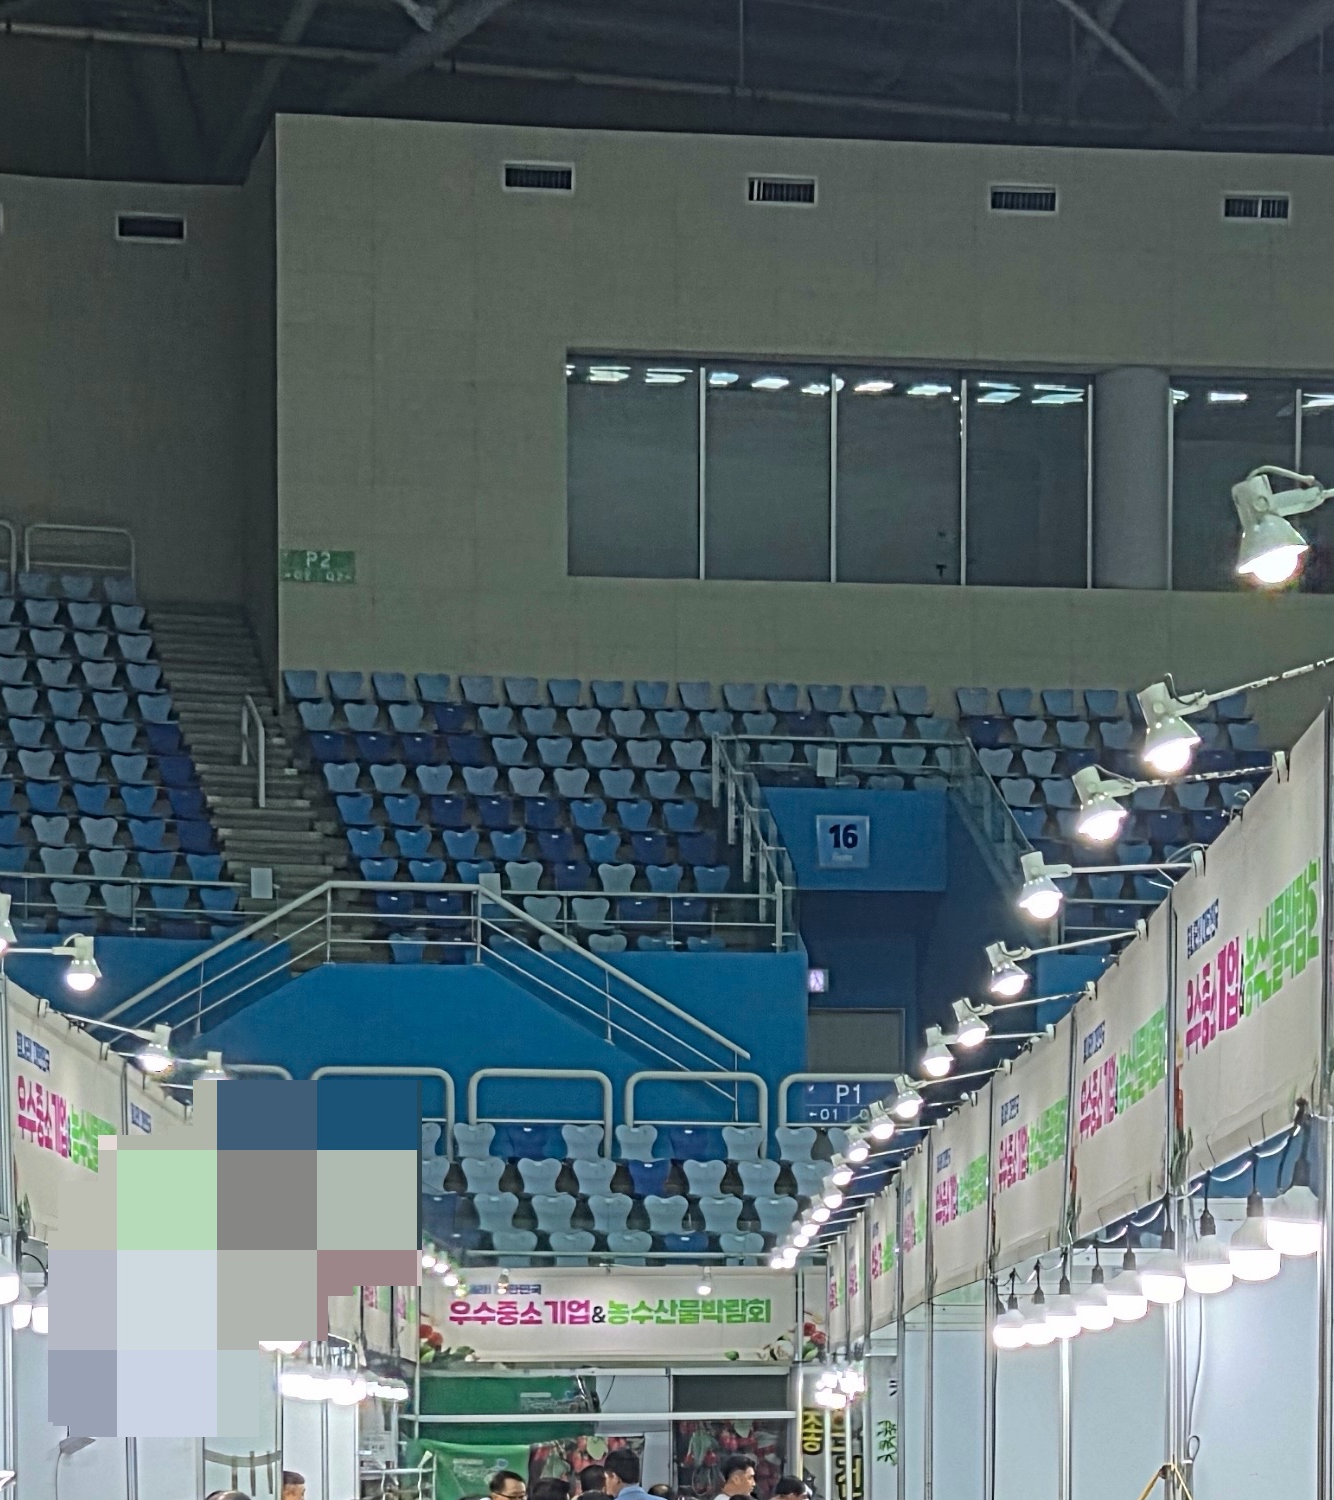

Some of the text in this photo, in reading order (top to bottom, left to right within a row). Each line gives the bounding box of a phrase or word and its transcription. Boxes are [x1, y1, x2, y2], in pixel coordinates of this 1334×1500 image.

[306, 551, 331, 569] P2
[829, 824, 858, 848] 16
[836, 1083, 861, 1104] P1
[448, 1298, 772, 1326] 우수중소기업&농수산물박람회
